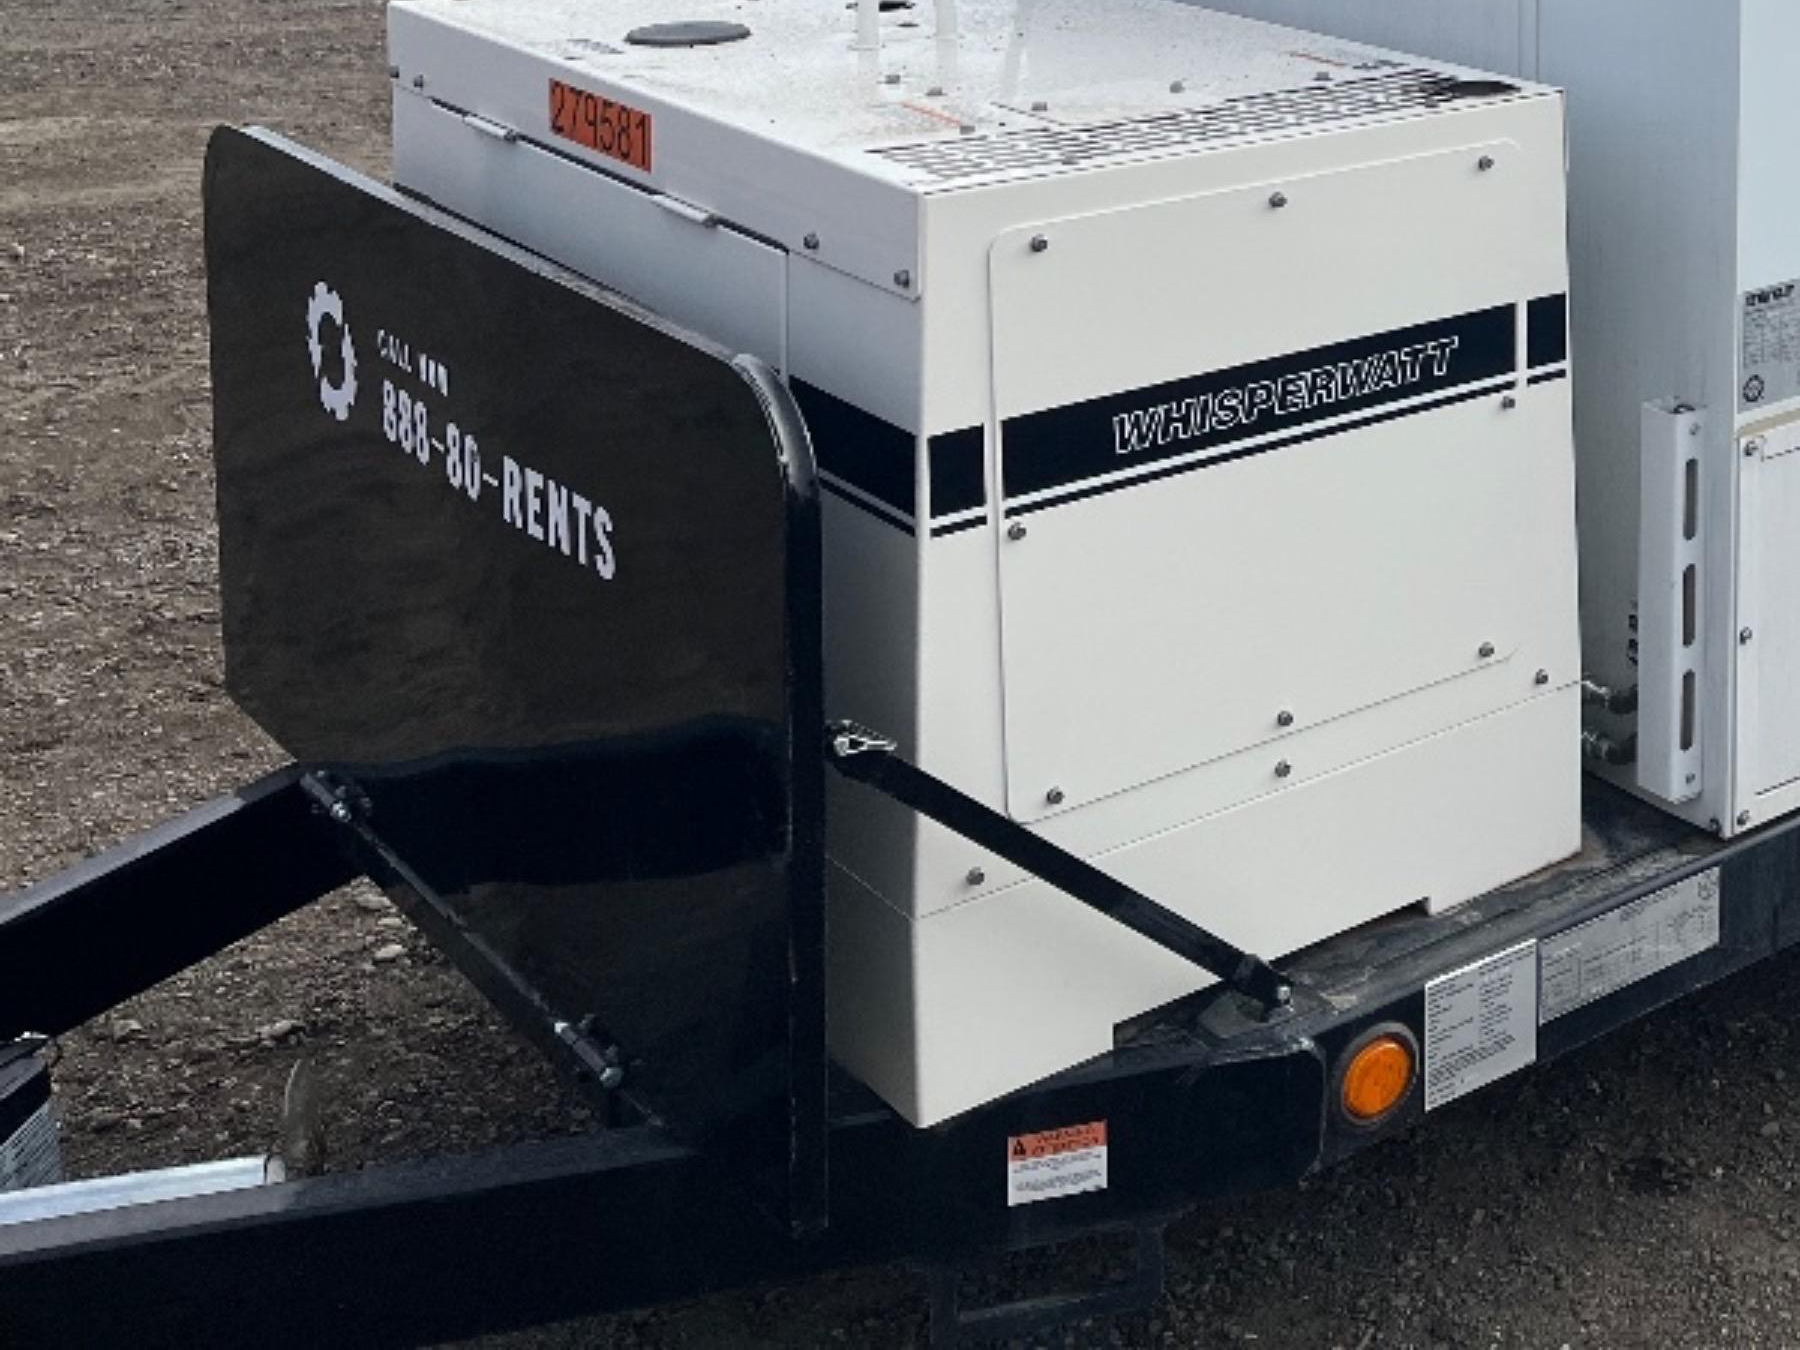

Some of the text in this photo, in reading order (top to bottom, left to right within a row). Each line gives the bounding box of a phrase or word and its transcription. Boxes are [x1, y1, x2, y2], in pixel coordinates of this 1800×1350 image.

[551, 80, 647, 167] 279581
[1112, 335, 1459, 454] WHISPERWATT
[382, 378, 616, 581] 888-80-RENTS
